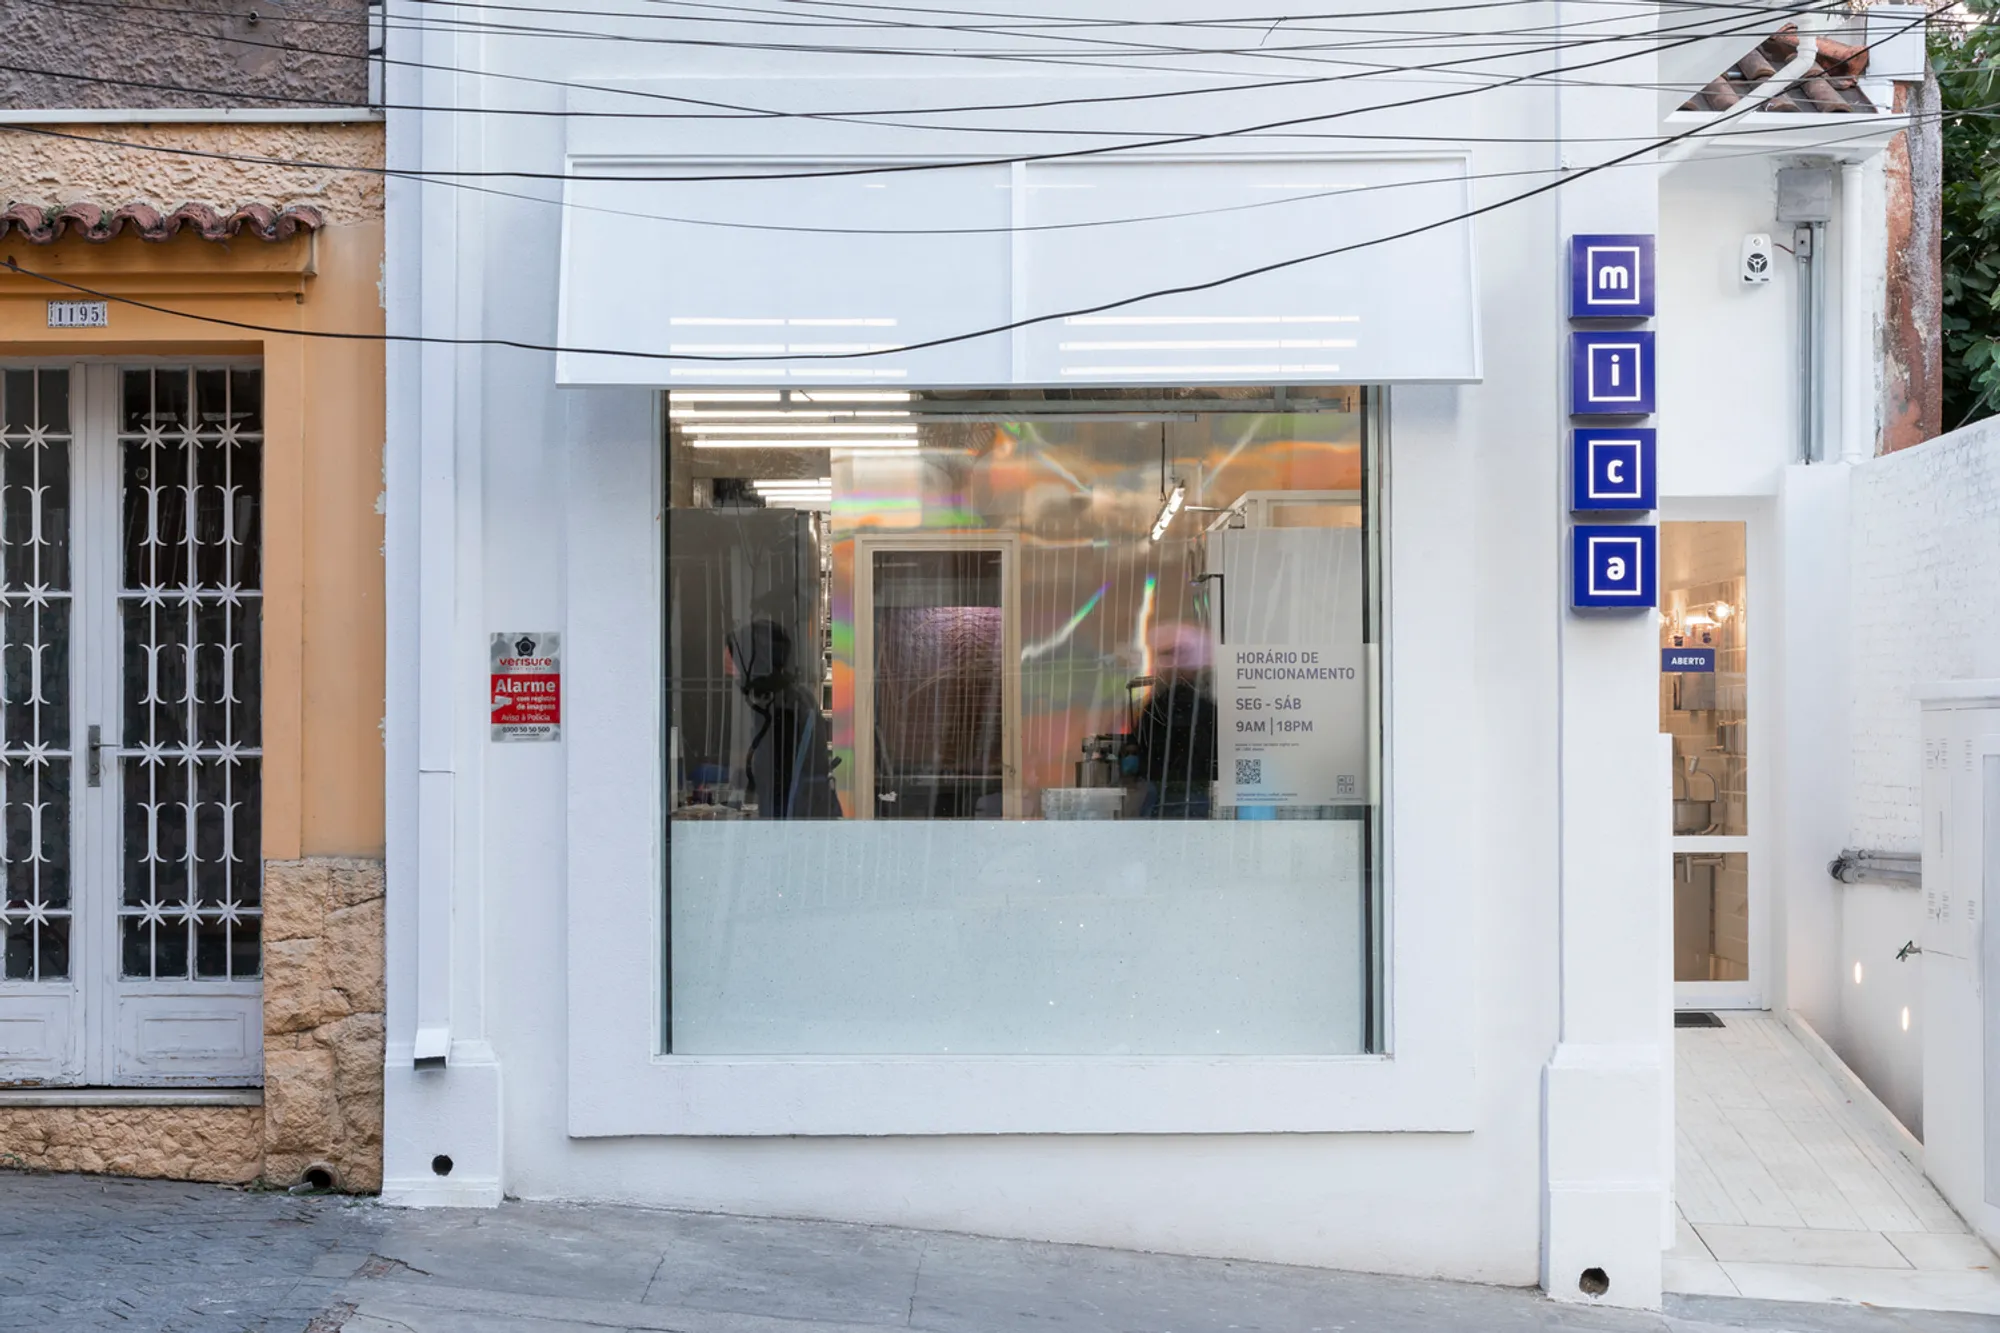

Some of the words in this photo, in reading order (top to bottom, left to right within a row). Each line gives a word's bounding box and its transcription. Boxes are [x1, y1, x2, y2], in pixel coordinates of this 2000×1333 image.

[57, 306, 99, 322] 1195
[499, 657, 552, 666] verisure
[1236, 649, 1297, 664] HORÁRIO
[1301, 652, 1319, 664] DE
[1671, 657, 1706, 665] ABERTO
[1236, 667, 1355, 680] FUNCIONAMENTO
[495, 678, 556, 693] Alarme
[1236, 698, 1262, 710] SEG
[1274, 695, 1302, 710] SÁB
[1236, 720, 1266, 732] 9AM
[1276, 720, 1313, 732] 18PM
